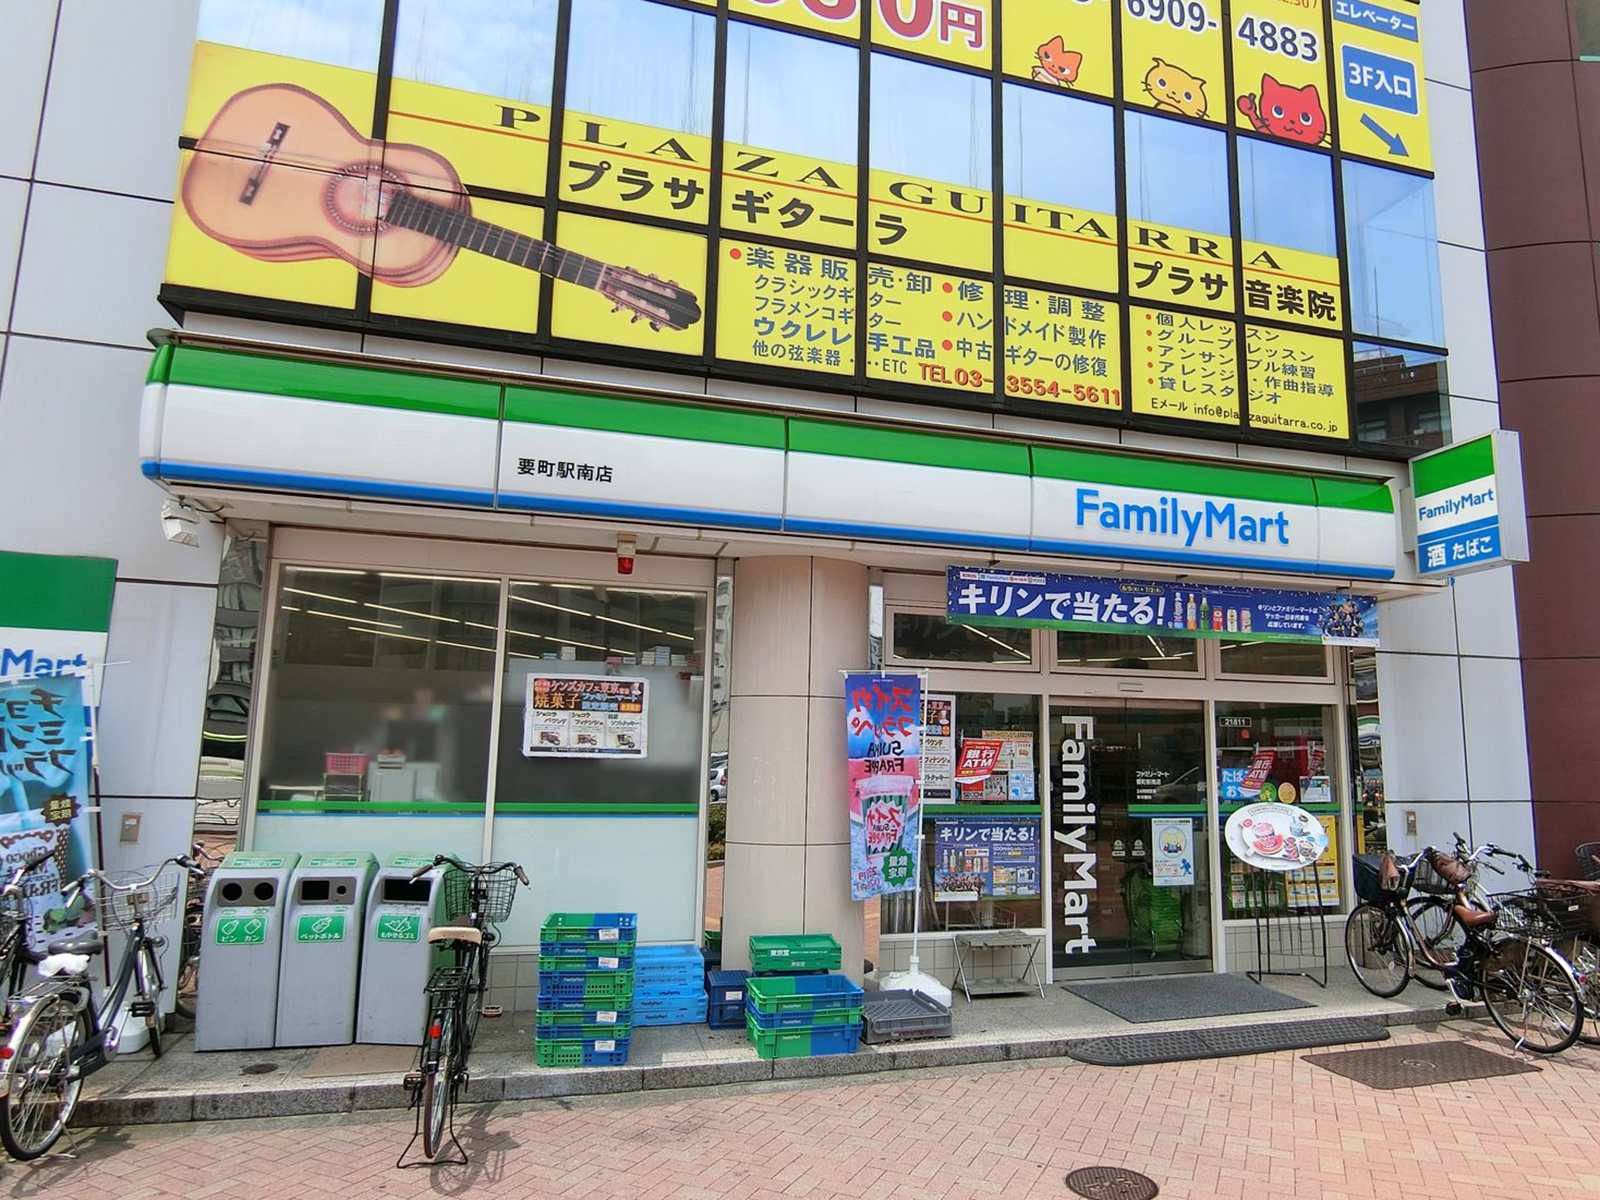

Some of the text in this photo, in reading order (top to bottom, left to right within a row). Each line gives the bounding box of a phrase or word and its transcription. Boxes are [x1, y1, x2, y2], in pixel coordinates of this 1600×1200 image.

[1336, 1, 1415, 31] エレベーター
[1348, 62, 1412, 98] 3F入口
[517, 457, 614, 483] 要町駅南店
[1076, 488, 1290, 547] FamilyMart
[1418, 488, 1494, 521] FamilyMart
[1427, 536, 1494, 568] 酒 たばこ
[957, 583, 1167, 626] キリンで当たる!
[962, 758, 994, 768] ATM
[966, 748, 997, 759] 銀行
[940, 826, 1035, 842] キリンで当たる!
[1053, 715, 1098, 955] FamilyMart
[300, 931, 342, 940] ペットボトル
